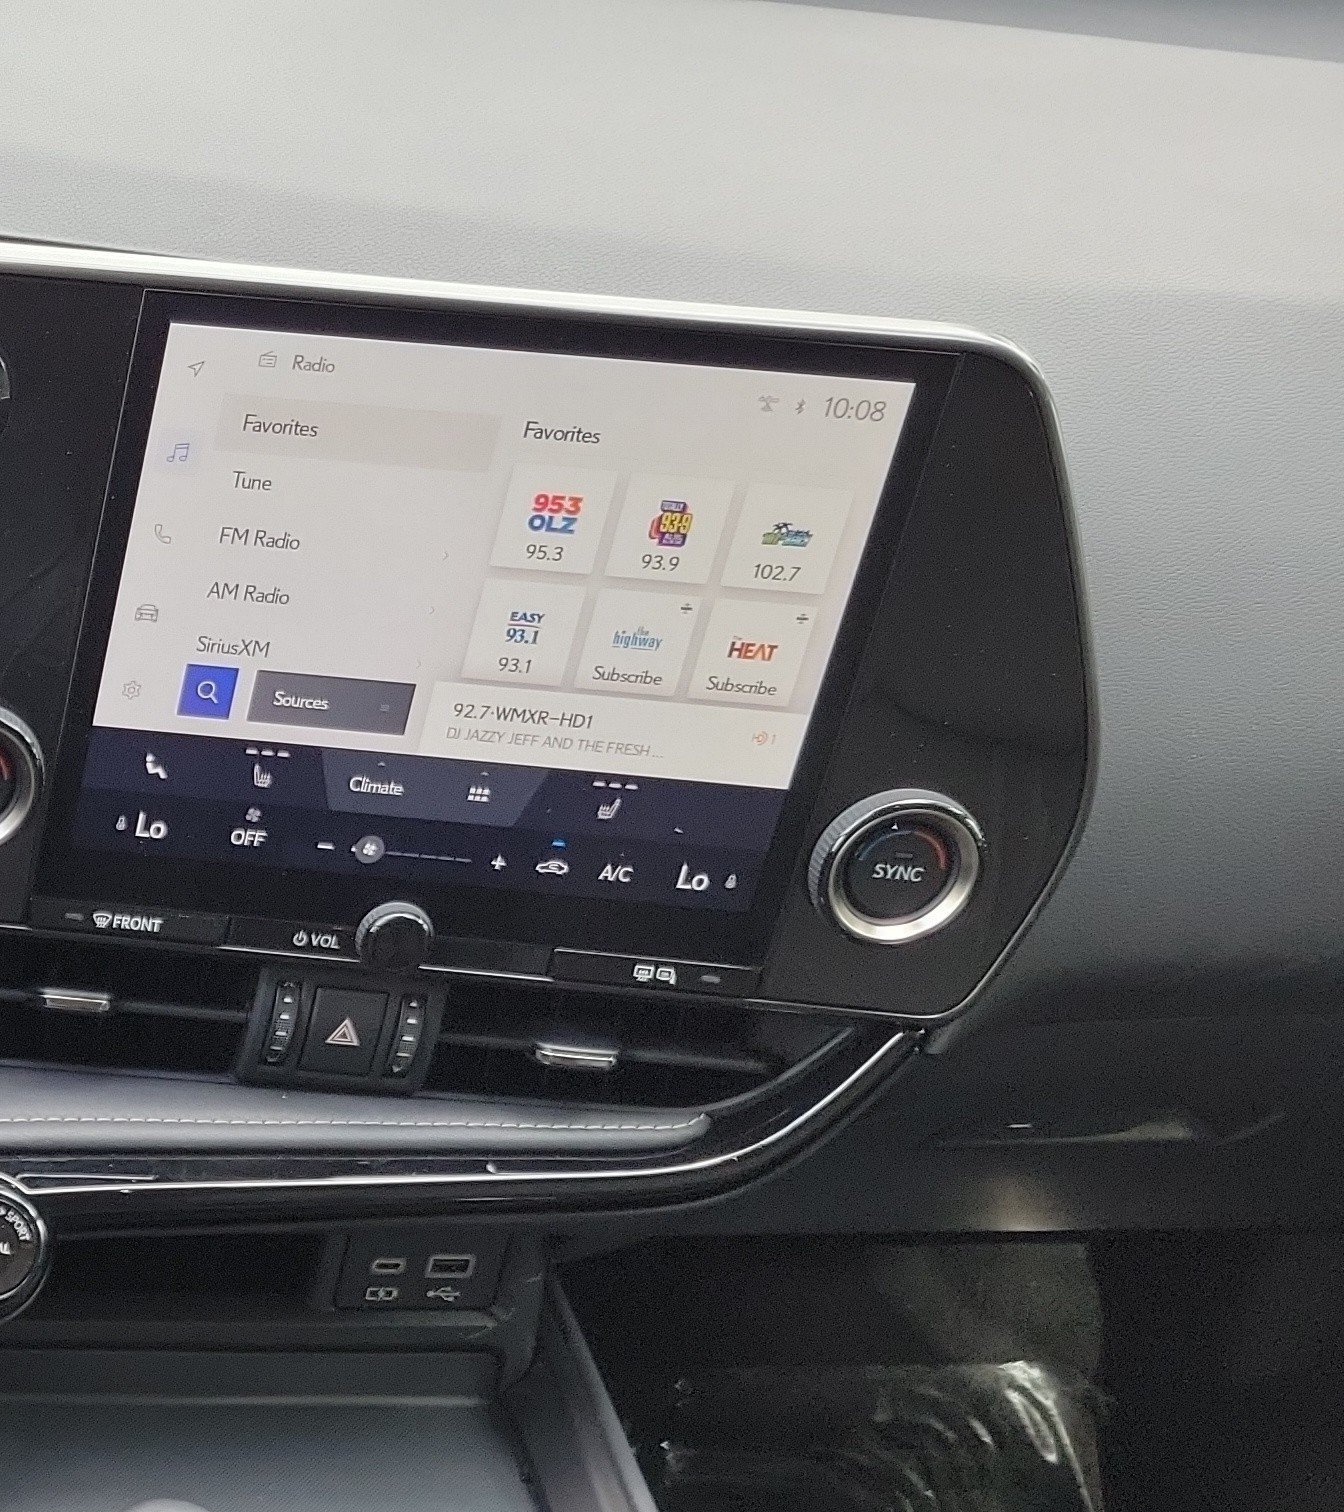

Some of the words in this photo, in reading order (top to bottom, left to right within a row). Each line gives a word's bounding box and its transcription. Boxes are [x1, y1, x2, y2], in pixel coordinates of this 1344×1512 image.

[292, 354, 336, 373] Radio
[824, 396, 886, 423] 10:08
[242, 413, 319, 438] Favorites
[523, 421, 601, 445] Favorites
[232, 470, 272, 491] Tune
[532, 493, 584, 516] 953
[528, 514, 578, 535] OLZ
[219, 526, 249, 546] FM
[254, 529, 300, 550] Radio
[525, 544, 564, 562] 95.3
[641, 553, 680, 572] 93.9
[753, 563, 801, 582] 102.7
[207, 581, 239, 601] AM
[244, 584, 290, 605] Radio
[509, 611, 545, 624] EASY
[505, 627, 539, 645] 93.1
[612, 630, 663, 651] highway
[196, 635, 270, 659] SiriusXM
[727, 641, 779, 661] HEAT
[498, 657, 532, 674] 93.1
[592, 665, 662, 686] Subscribe
[706, 675, 777, 696] Subscribe
[273, 690, 330, 711] Sources
[446, 727, 461, 740] DJ
[463, 728, 505, 744] JAZZY
[507, 732, 540, 747] JEFF
[541, 735, 573, 751] AND
[578, 738, 605, 754] THE
[605, 741, 651, 757] FRESH
[349, 775, 404, 797] Climate
[135, 810, 166, 839] Lo
[231, 828, 268, 847] OFF
[598, 864, 634, 882] A/C
[675, 862, 710, 891] Lo
[872, 863, 926, 883] SYNC
[112, 915, 163, 933] FRONT
[311, 933, 340, 949] VOL
[4, 1211, 32, 1241] SPORT
